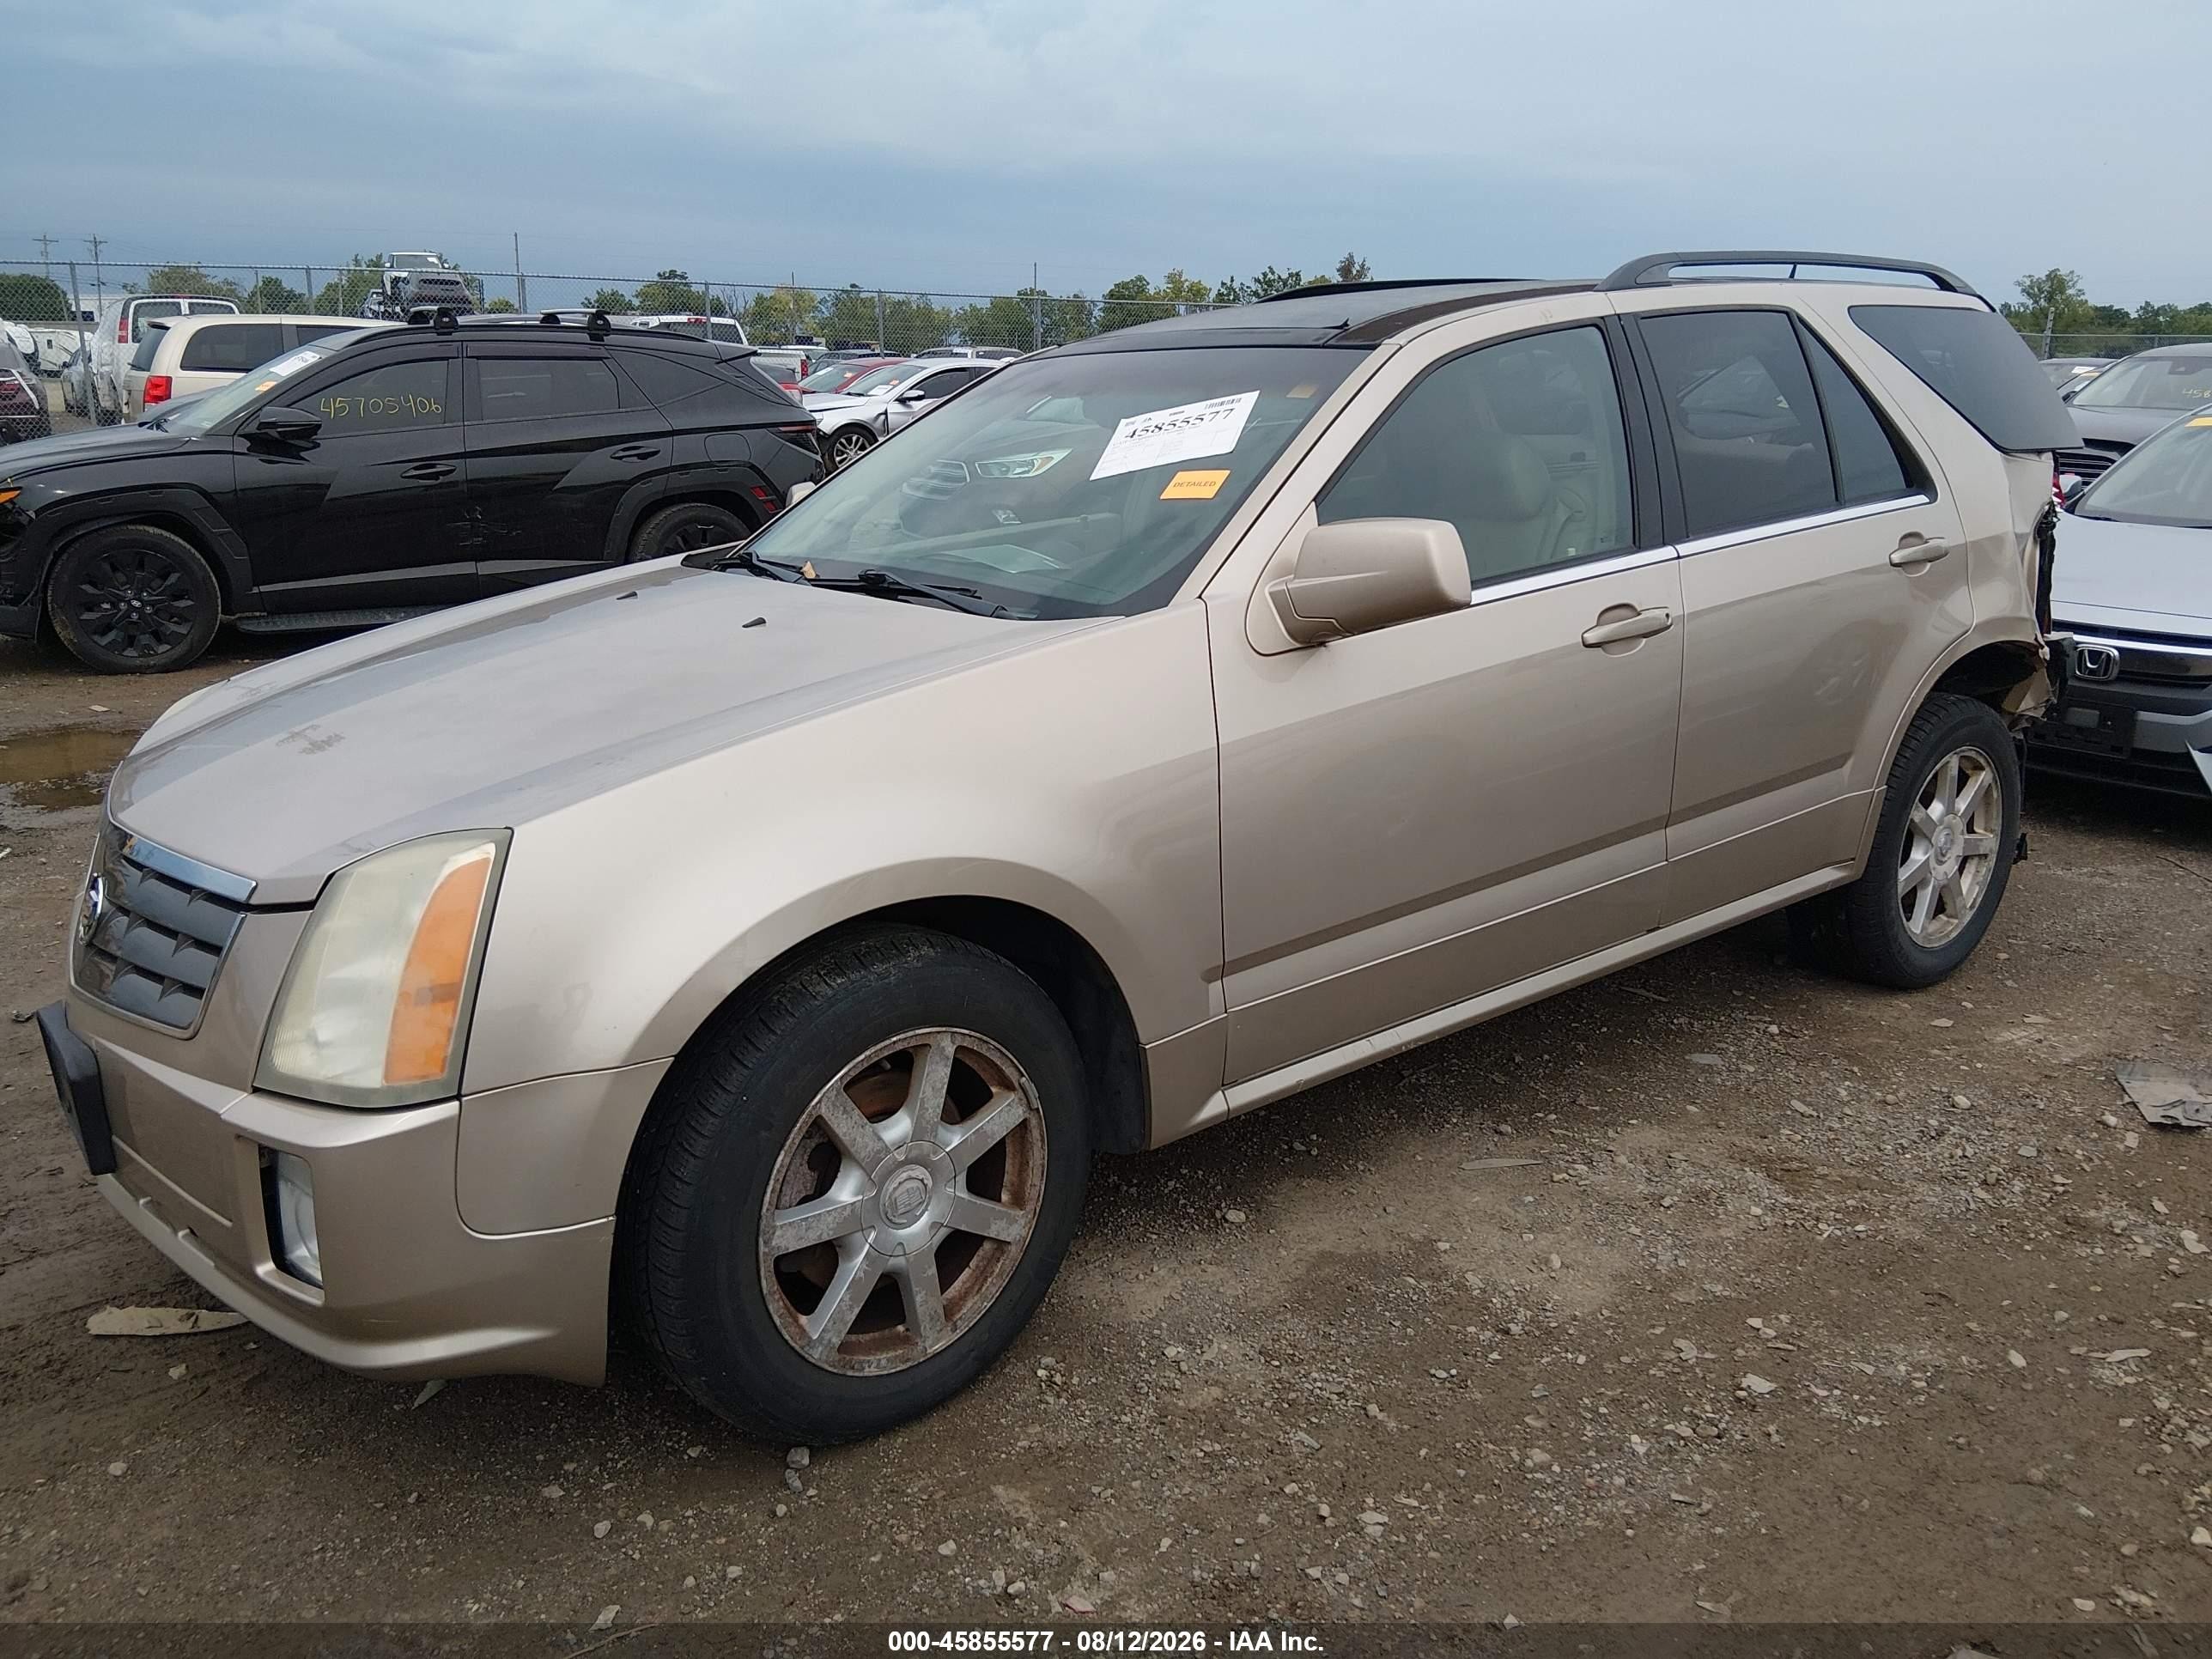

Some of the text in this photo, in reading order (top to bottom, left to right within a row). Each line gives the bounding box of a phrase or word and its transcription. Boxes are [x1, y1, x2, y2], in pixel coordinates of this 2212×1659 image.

[320, 392, 442, 419] 45705406
[1124, 408, 1236, 440] 45855577
[1173, 480, 1217, 489] DETAILED
